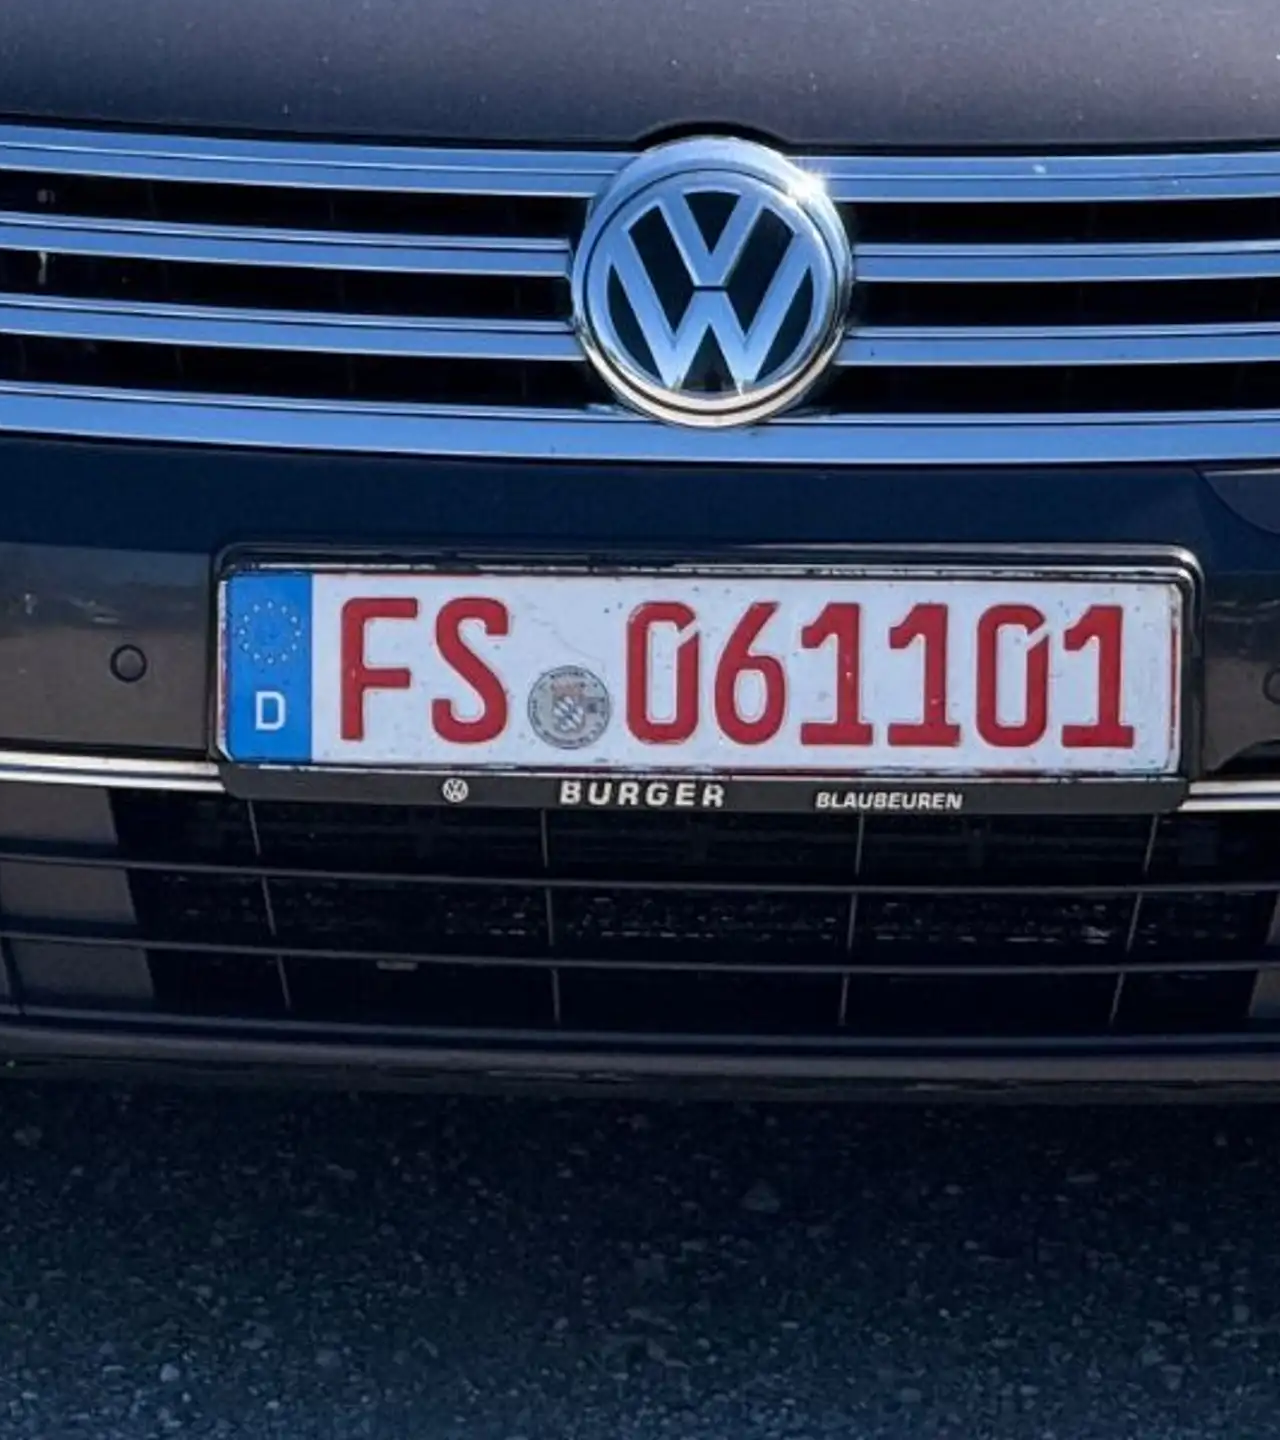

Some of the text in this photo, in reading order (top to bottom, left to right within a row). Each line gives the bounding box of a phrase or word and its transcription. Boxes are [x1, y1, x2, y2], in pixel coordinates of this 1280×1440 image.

[600, 178, 825, 400] VW
[340, 596, 510, 744] FS
[625, 600, 1136, 750] 061101
[255, 690, 287, 731] D
[559, 779, 725, 808] BURGER
[815, 790, 964, 810] BLAUBEUREN
